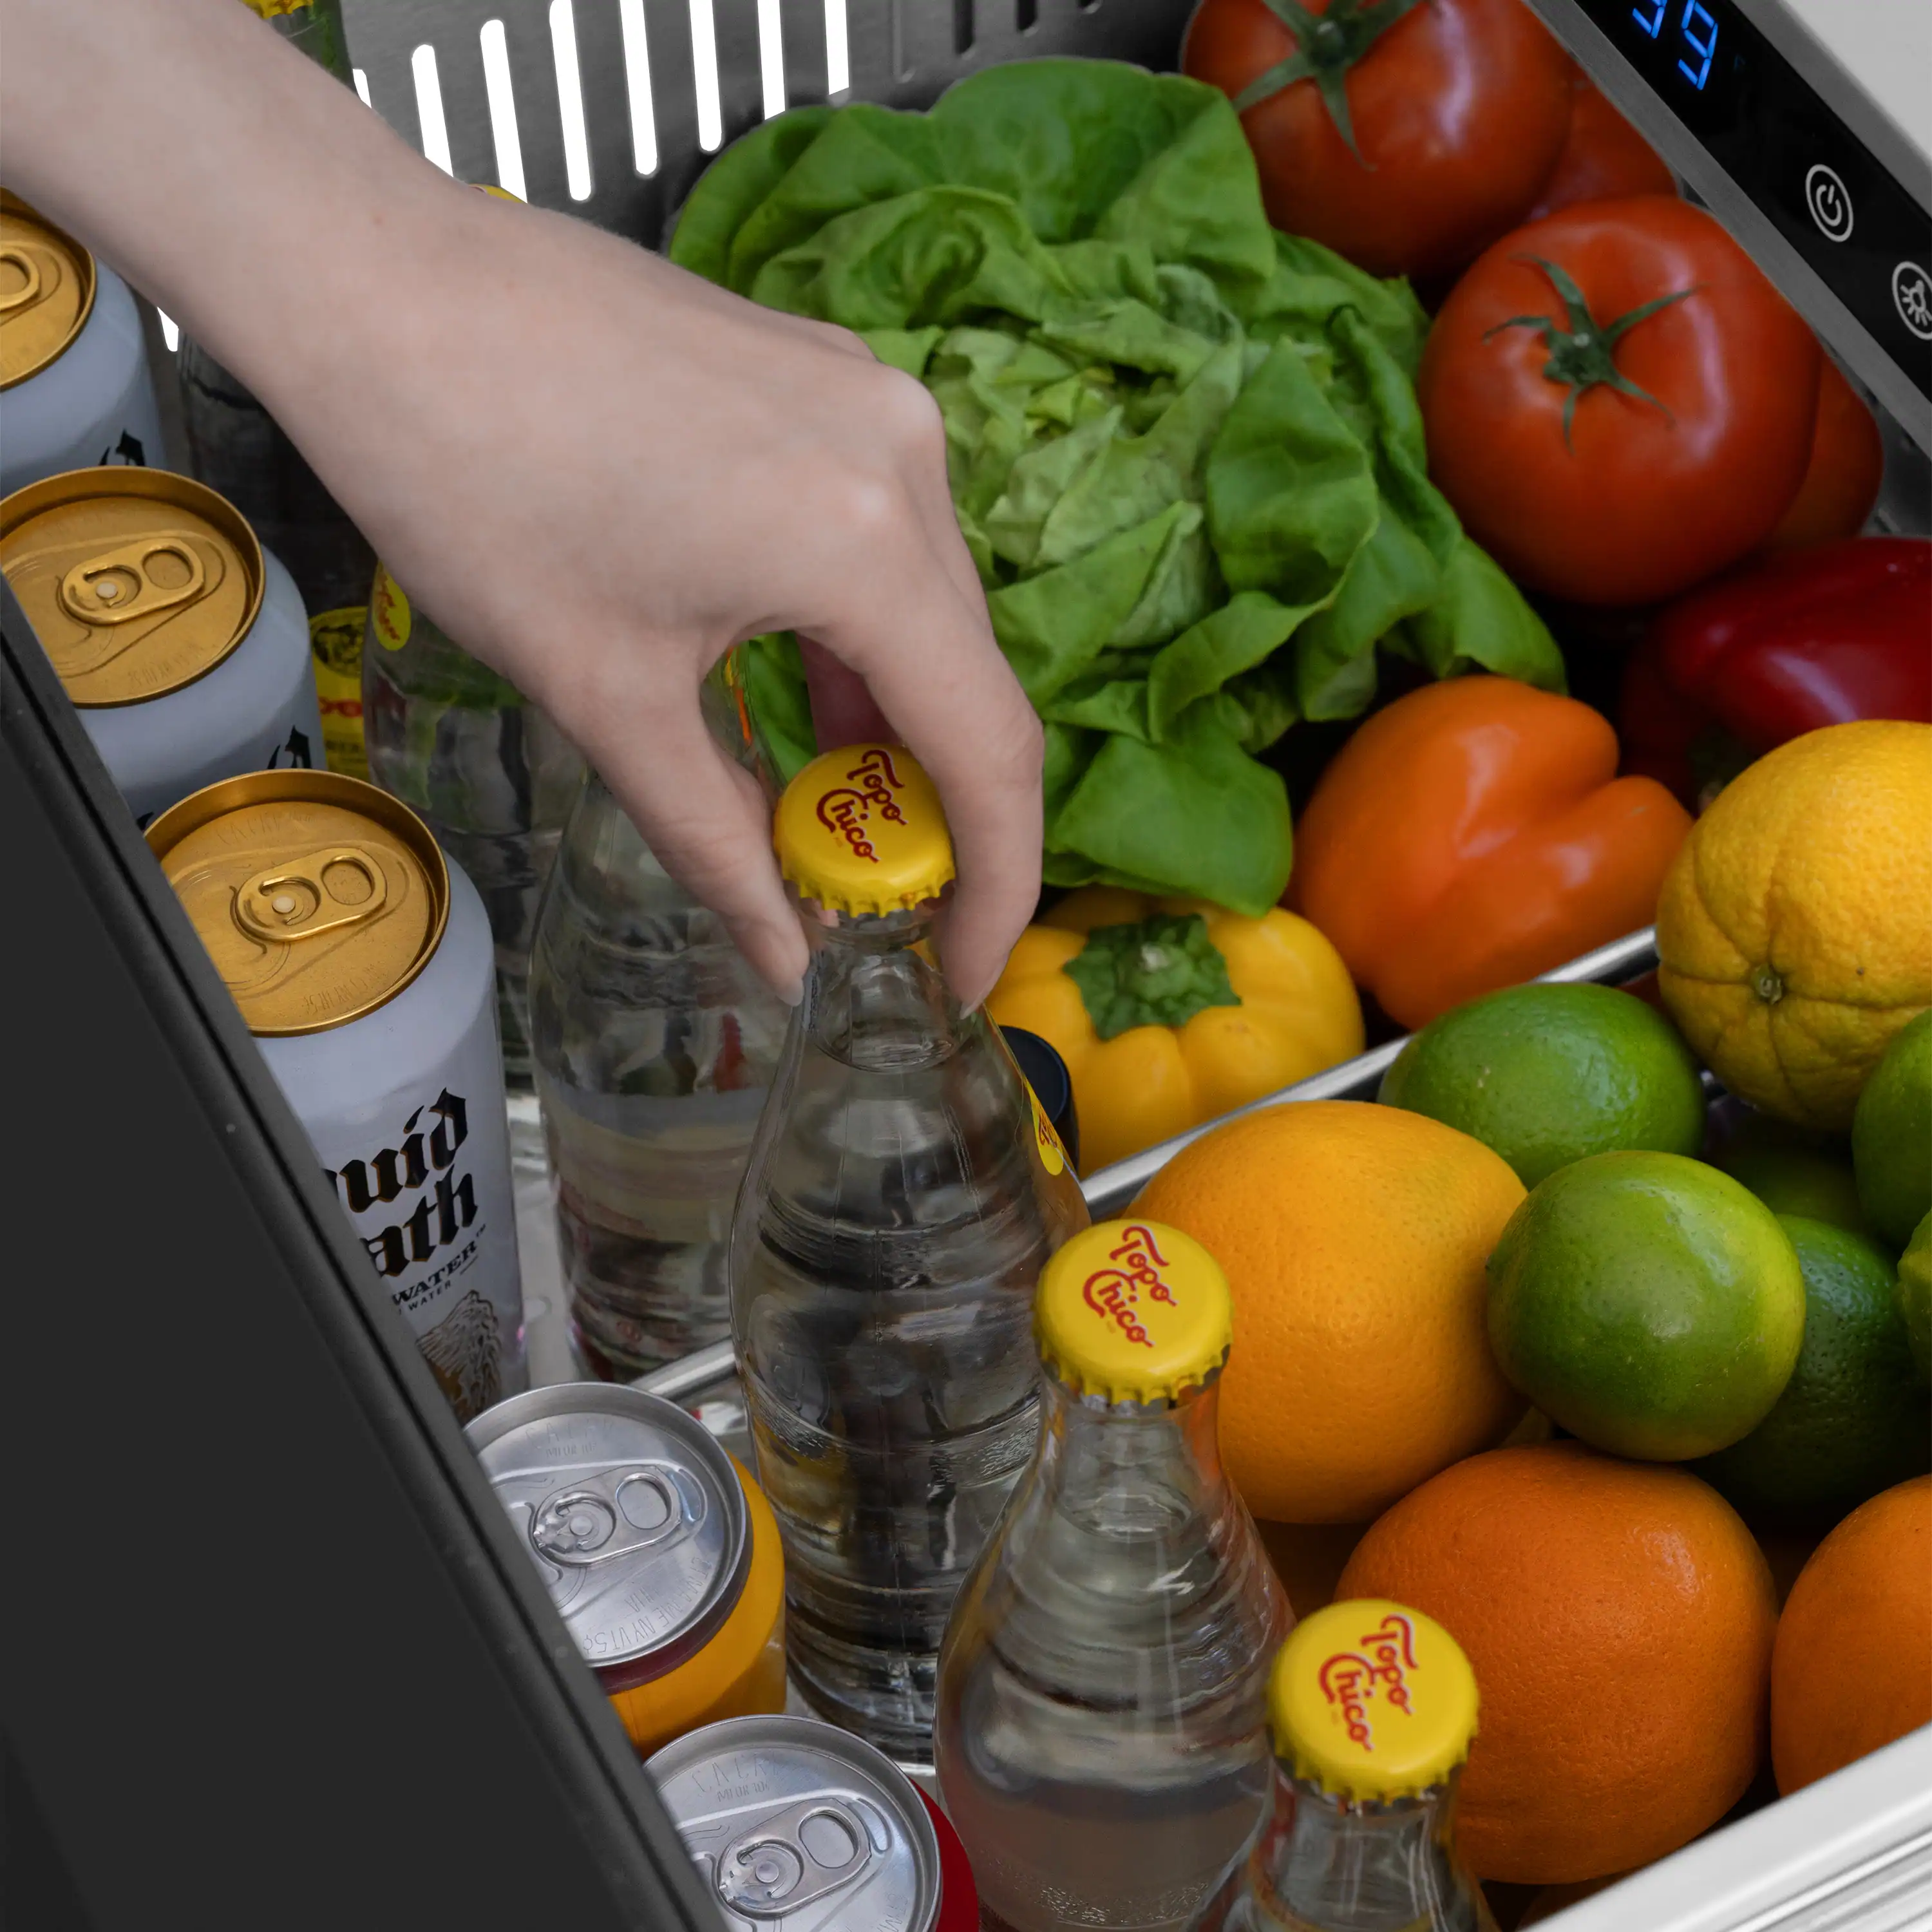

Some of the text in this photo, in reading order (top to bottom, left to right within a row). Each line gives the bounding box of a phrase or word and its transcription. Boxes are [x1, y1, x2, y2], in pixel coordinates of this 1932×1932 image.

[816, 788, 880, 864] Chico
[846, 749, 909, 826] Topo
[321, 1087, 468, 1213] uid
[392, 1240, 477, 1305] WATER
[1108, 1225, 1179, 1307] Topo
[1082, 1269, 1155, 1349] Chico
[611, 1627, 631, 1651] VT
[632, 1617, 656, 1643] NY
[1359, 1613, 1419, 1716] Topo
[1318, 1651, 1376, 1752] Chico
